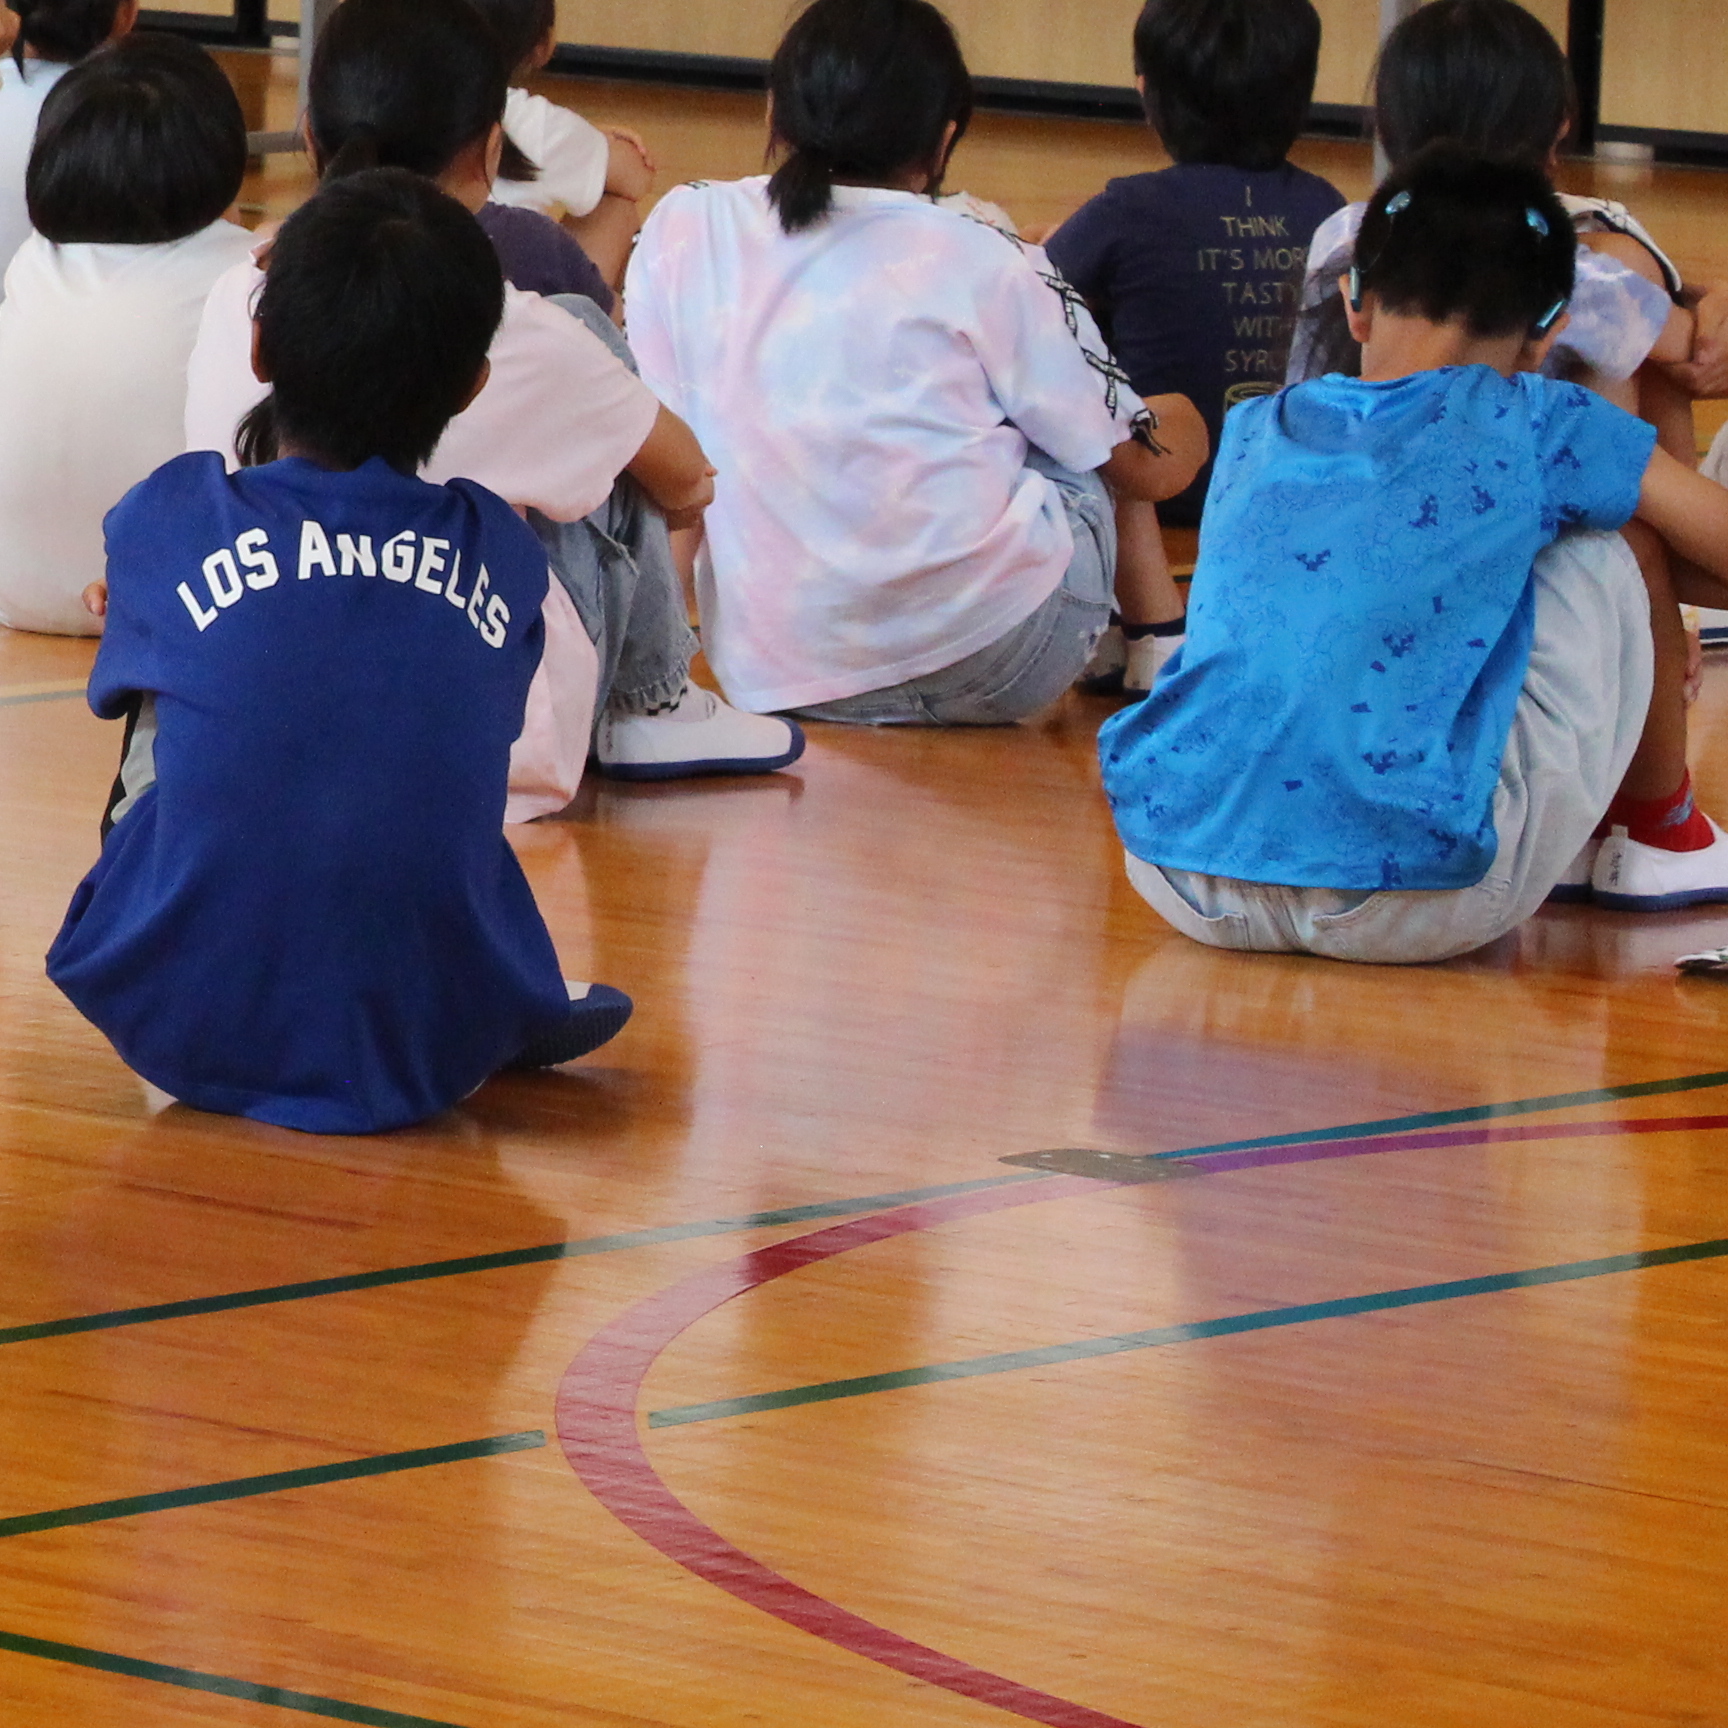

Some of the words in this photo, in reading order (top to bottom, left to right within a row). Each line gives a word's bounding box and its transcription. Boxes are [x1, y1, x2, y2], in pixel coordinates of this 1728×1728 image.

[1245, 185, 1252, 207] I
[1219, 216, 1289, 237] THINK
[1197, 248, 1245, 271] IT'S
[1254, 247, 1309, 271] MOR
[176, 527, 280, 632] LOS
[298, 520, 511, 649] ANGELES
